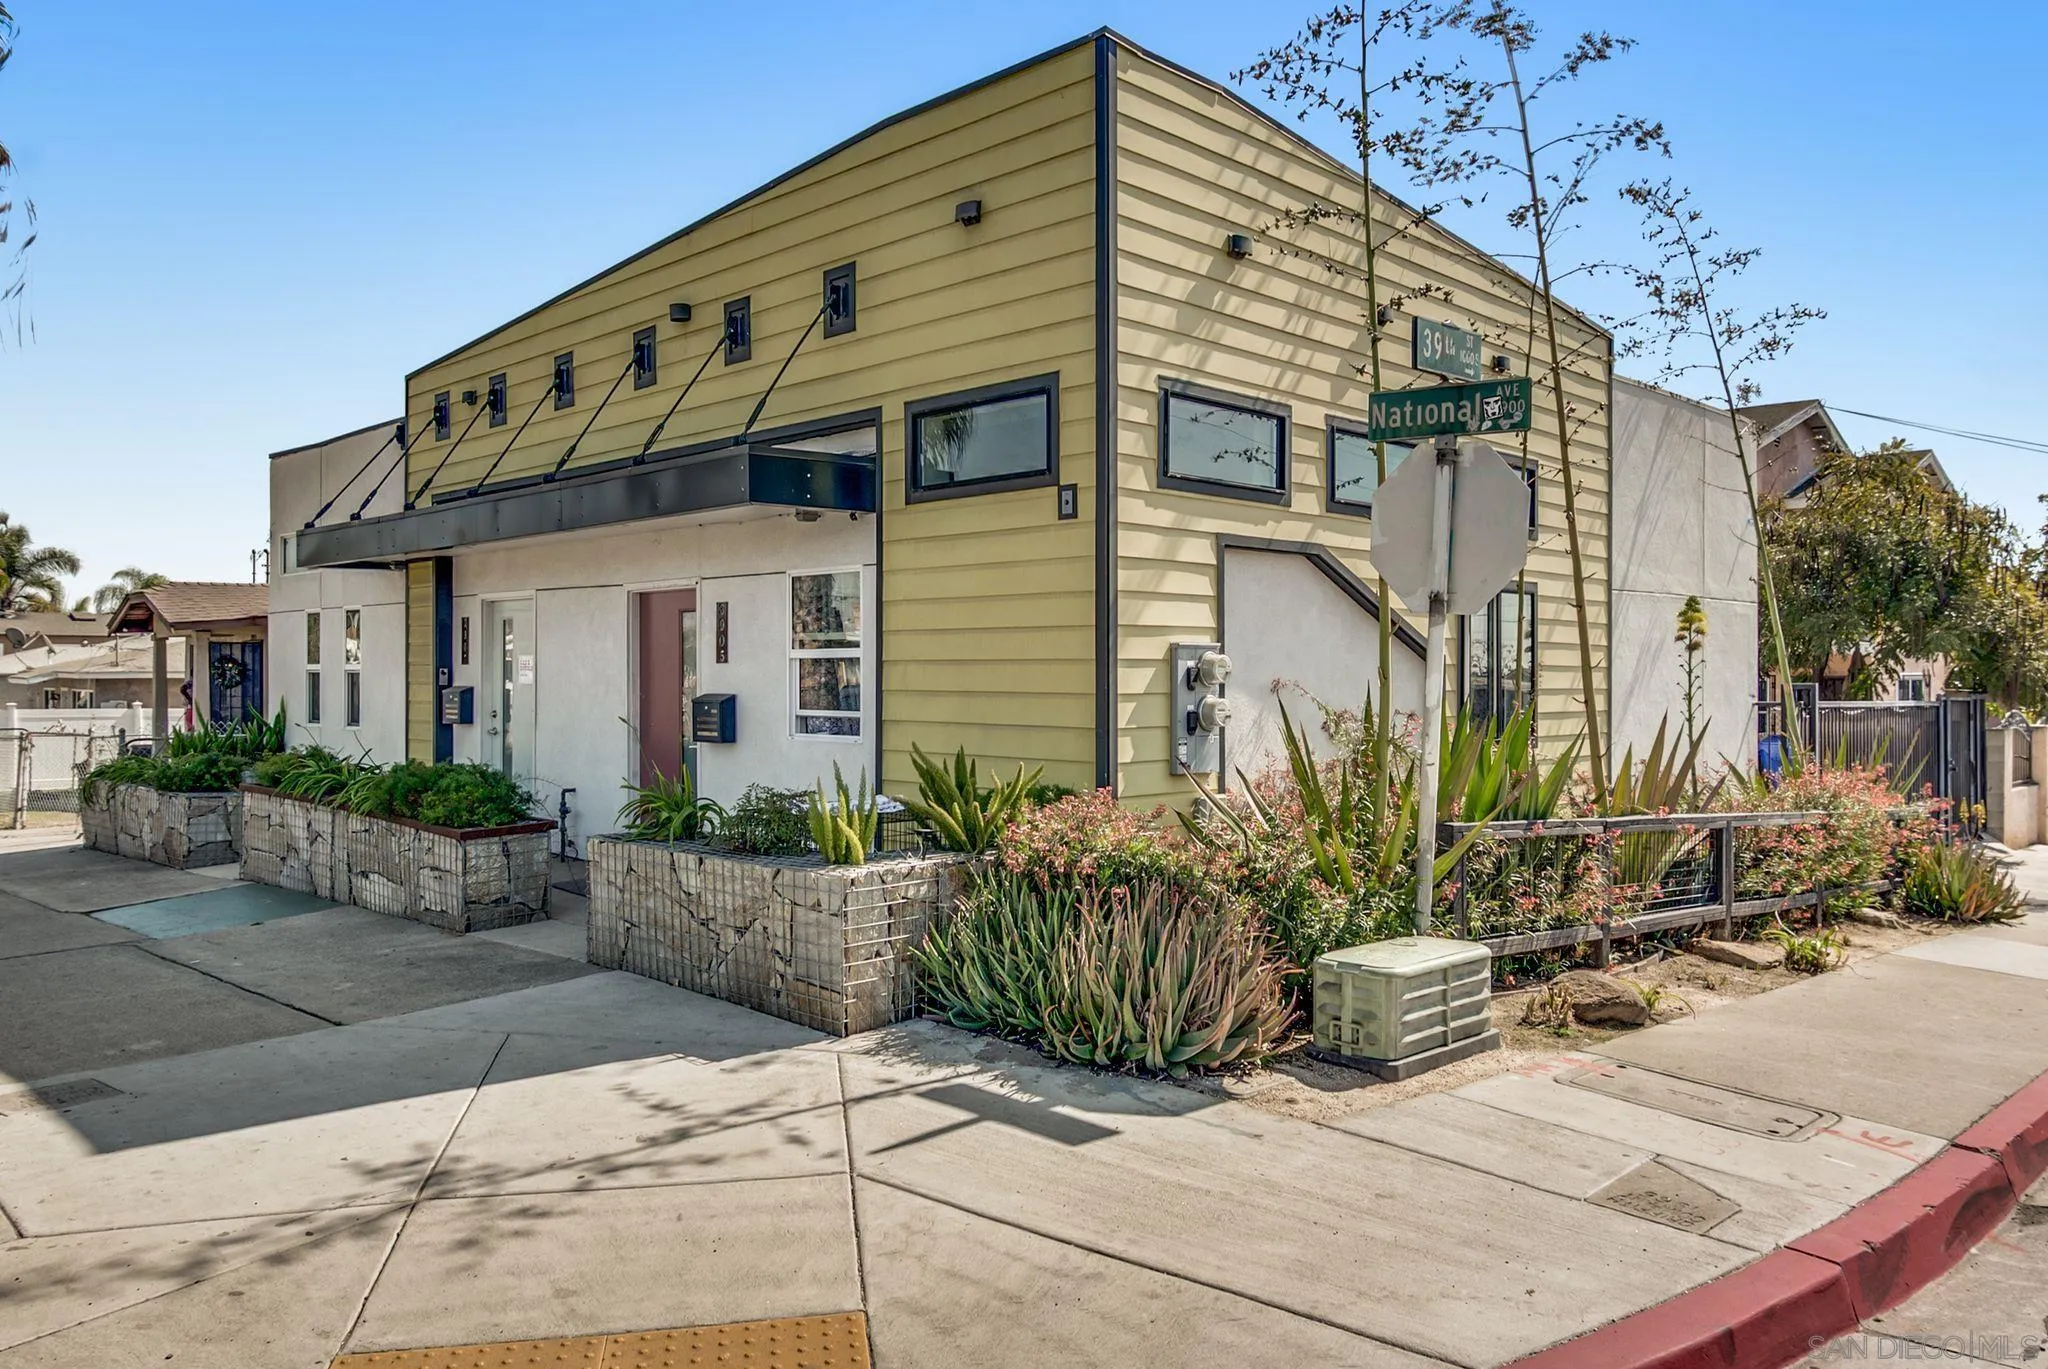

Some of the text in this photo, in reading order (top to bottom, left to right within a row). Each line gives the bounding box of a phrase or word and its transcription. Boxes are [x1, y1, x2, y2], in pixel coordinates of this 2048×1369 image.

[1465, 335, 1475, 349] ST
[1496, 383, 1521, 397] AVE
[1371, 392, 1481, 430] National
